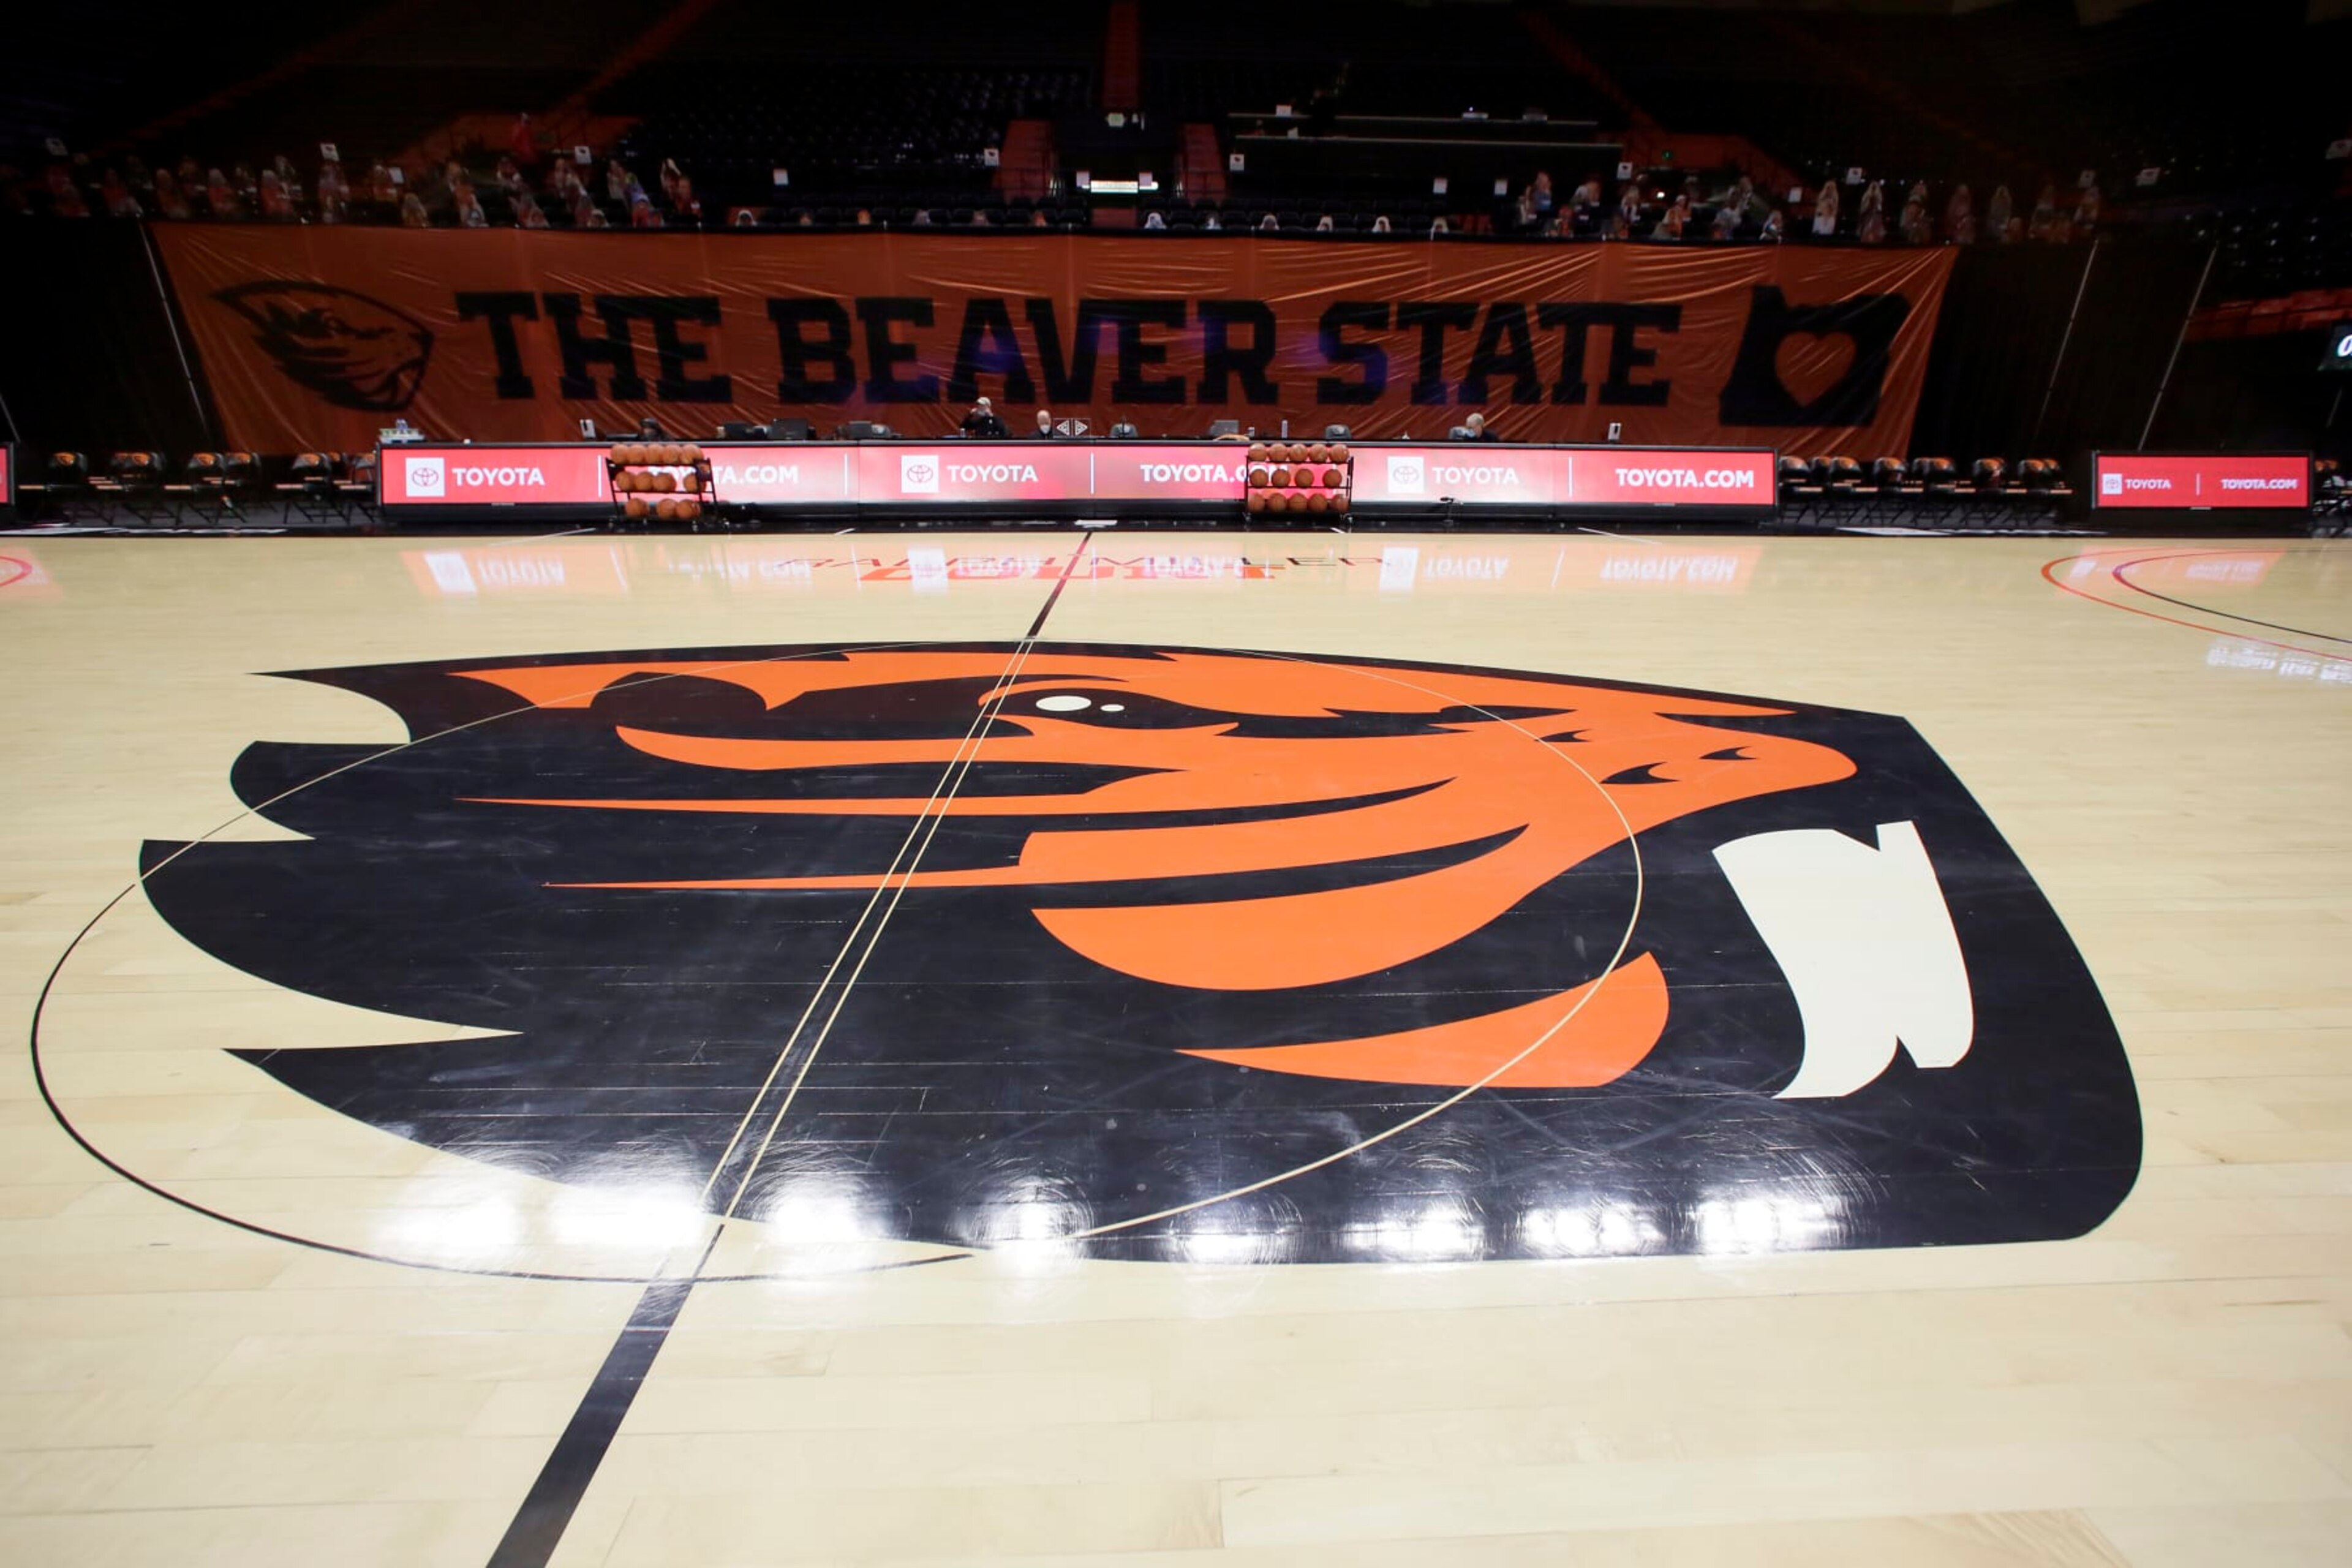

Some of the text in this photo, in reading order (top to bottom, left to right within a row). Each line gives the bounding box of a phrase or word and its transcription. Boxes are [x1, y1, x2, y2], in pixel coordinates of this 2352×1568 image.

[455, 292, 1682, 406] THE BEAVER STATE
[452, 467, 545, 486] TOYOTA
[647, 466, 799, 484] TOYTA.COM
[947, 465, 1038, 483] TOYOTA
[1432, 467, 1519, 485] TOYOTA
[1616, 468, 1754, 488] TOYOTA.COM
[2125, 478, 2171, 489] TOYOTA
[2220, 478, 2297, 489] TOYOTA.COM
